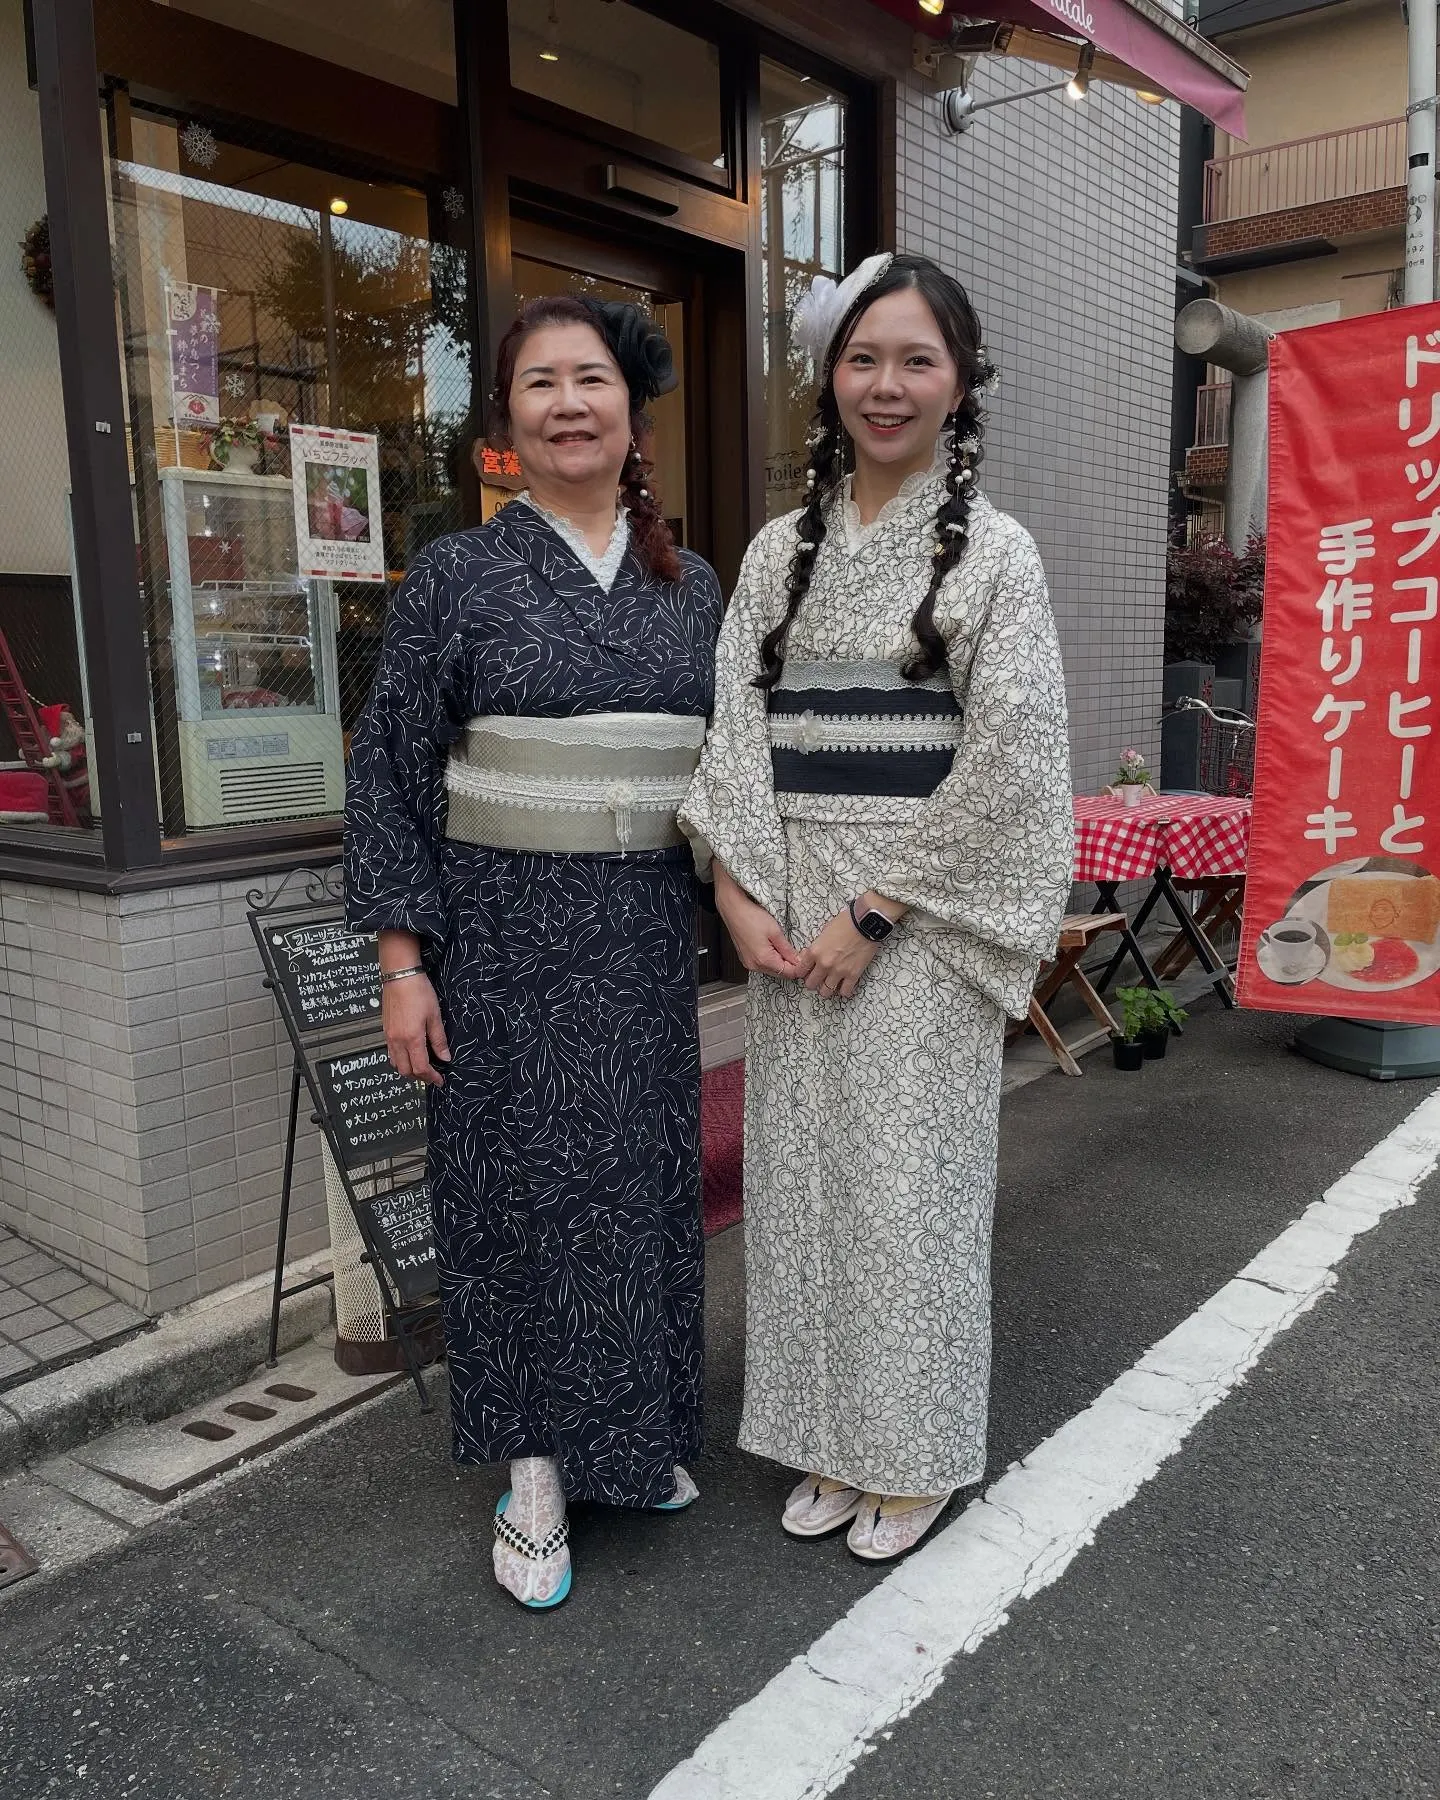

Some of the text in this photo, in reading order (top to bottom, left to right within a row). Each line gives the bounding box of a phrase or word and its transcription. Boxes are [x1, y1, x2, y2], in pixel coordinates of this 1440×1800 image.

[1051, 0, 1095, 34] atale
[302, 448, 369, 466] いちごフラッペ
[481, 447, 522, 476] 営業
[765, 463, 804, 482] Toile
[1380, 330, 1440, 854] ドリップコーヒーと
[1303, 518, 1376, 855] 手作りケーキ
